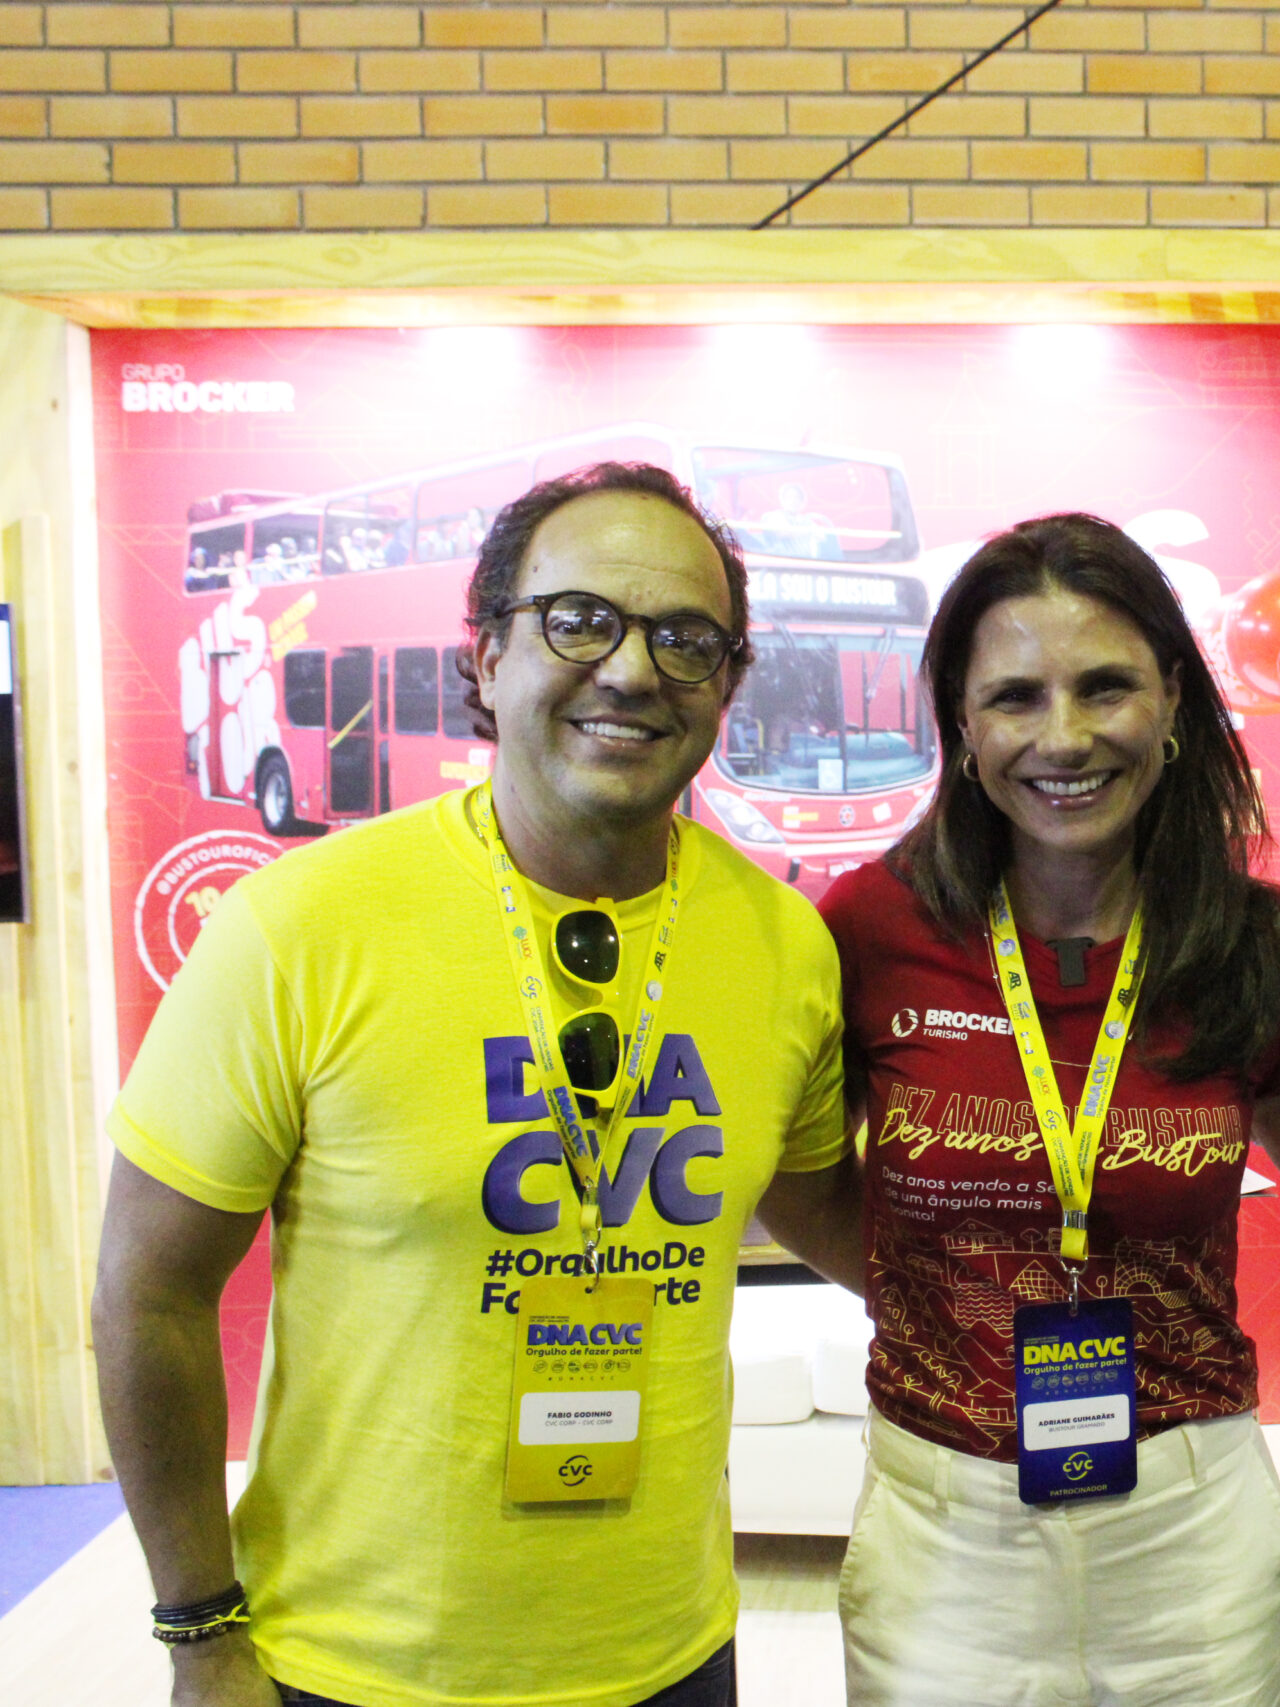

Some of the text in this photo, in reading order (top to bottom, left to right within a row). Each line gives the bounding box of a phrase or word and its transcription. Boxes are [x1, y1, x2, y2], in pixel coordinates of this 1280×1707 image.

[121, 362, 186, 382] GRUPO
[121, 380, 295, 413] BROCKER
[155, 844, 277, 896] @BUSTOUROFIC
[526, 976, 538, 999] CVC
[922, 1028, 968, 1041] TURISMO
[885, 1082, 936, 1132] DEZ
[937, 1092, 1036, 1141] ANOS
[1105, 1105, 1243, 1151] BUSTOUR
[1045, 1109, 1058, 1131] CVC
[877, 1107, 941, 1160] Dez
[944, 1131, 1044, 1161] anos
[481, 1124, 724, 1236] CVC
[882, 1165, 1058, 1194] Dez anos vendo a Se
[901, 1192, 923, 1205] um
[927, 1194, 991, 1210] ângulo
[996, 1196, 1043, 1210] mais
[526, 1347, 643, 1358] Orgulho de fazer parte!
[1023, 1357, 1127, 1376] Orgulho de fazer parte!
[574, 1410, 612, 1418] GODINHO
[1038, 1412, 1116, 1428] ADRIANE GUIMARÃES
[558, 1463, 592, 1477] CVC
[1062, 1459, 1094, 1473] CVC
[1050, 1484, 1108, 1497] PATROCINADOR
